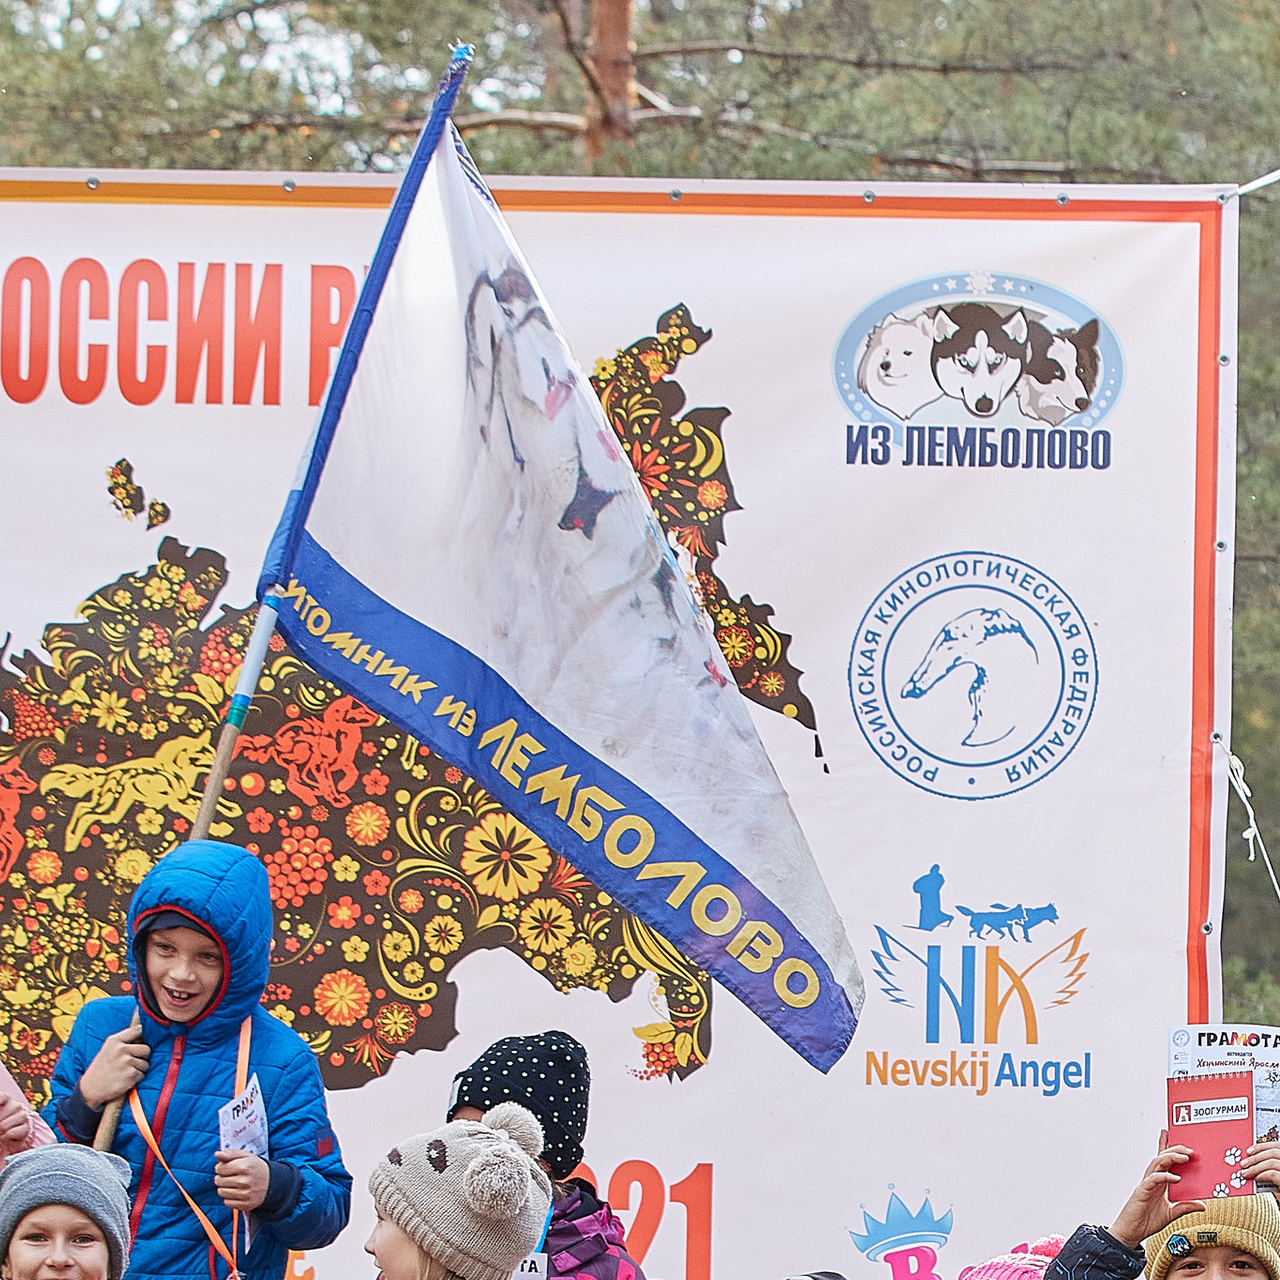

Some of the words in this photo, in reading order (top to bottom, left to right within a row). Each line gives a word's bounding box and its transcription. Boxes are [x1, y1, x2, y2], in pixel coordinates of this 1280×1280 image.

[846, 425, 891, 465] ИЗ
[902, 426, 1112, 470] ЛЕМБОЛОВО
[874, 559, 1082, 640] КИНОЛОГИЧЕСКАЯ
[857, 629, 939, 783] РОССИЙСКАЯ
[1004, 647, 1090, 784] ФЕДЕРАЦИЯ
[283, 579, 437, 703] ИТОМНИК
[433, 694, 477, 738] ИЗ
[478, 718, 821, 1009] ЛЕМБОЛОВО
[866, 1051, 989, 1096] Nevskij
[995, 1053, 1091, 1097] Angel
[1193, 1104, 1247, 1117] ЗООГУРМАН
